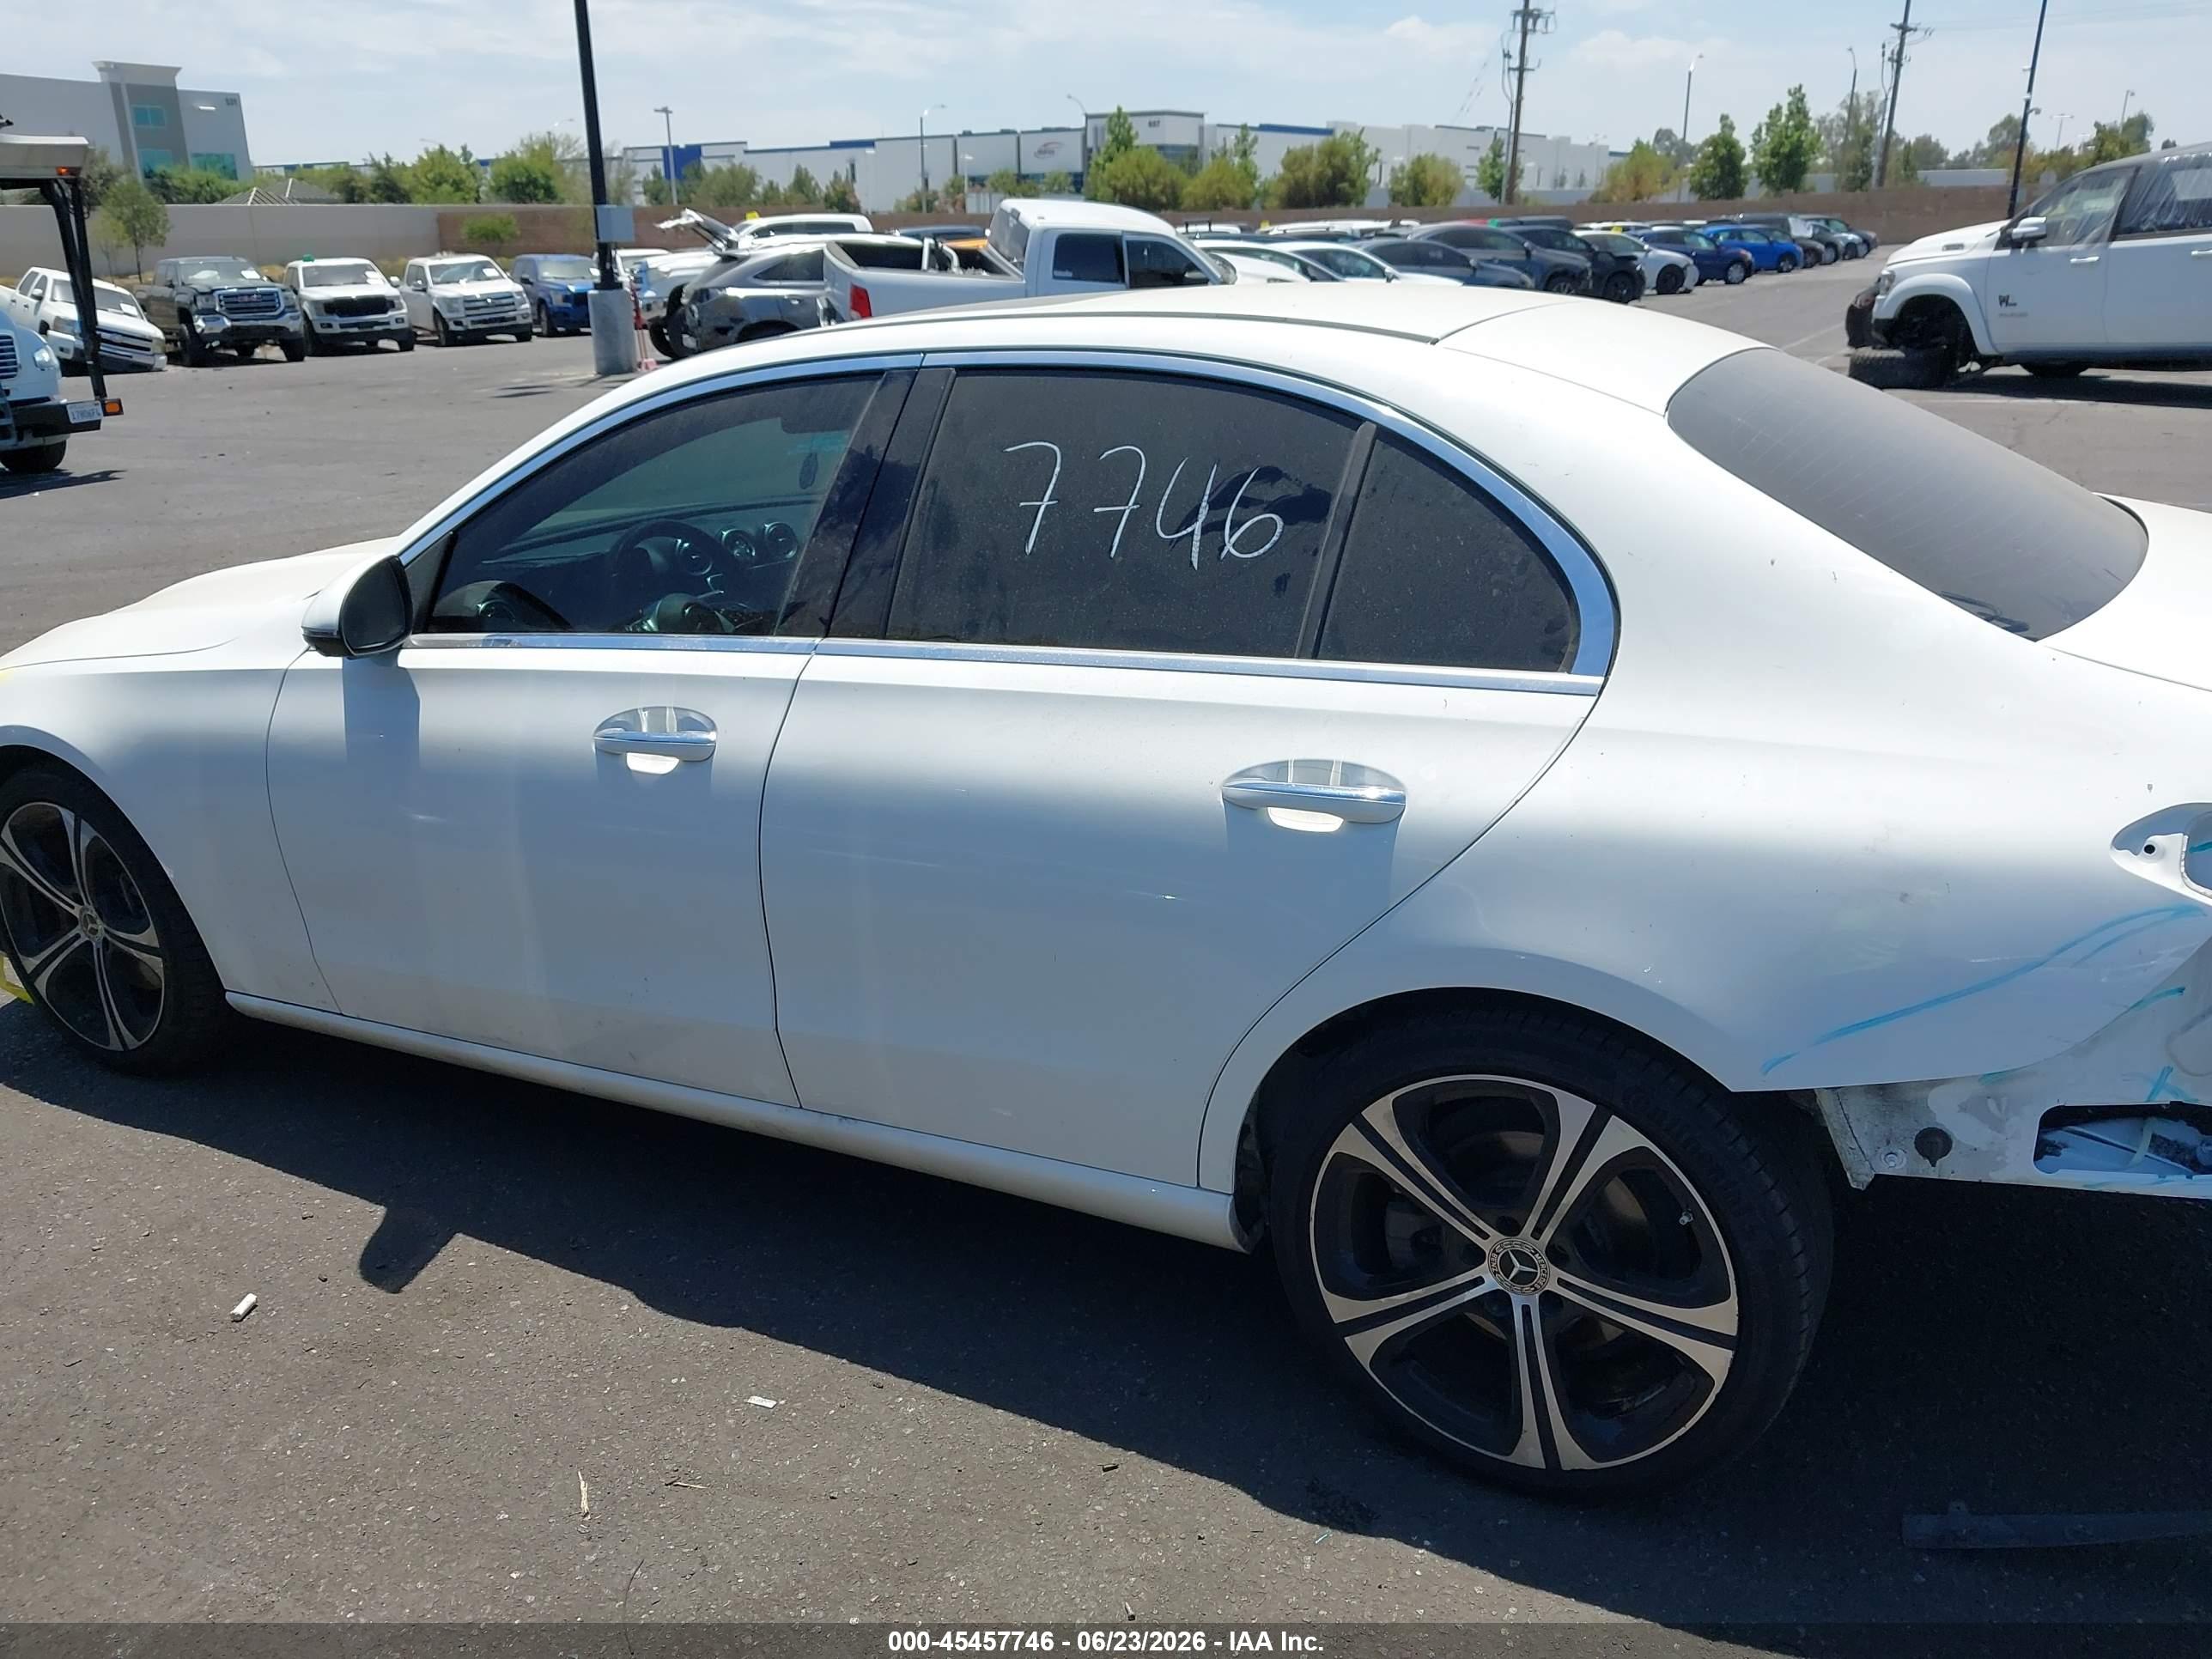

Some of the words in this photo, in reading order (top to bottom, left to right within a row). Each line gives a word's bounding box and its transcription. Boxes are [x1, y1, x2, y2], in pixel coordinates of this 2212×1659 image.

[1002, 440, 1285, 572] 7746
[1488, 1251, 1499, 1274] BENZ
[1533, 1252, 1548, 1290] MERCEDES
